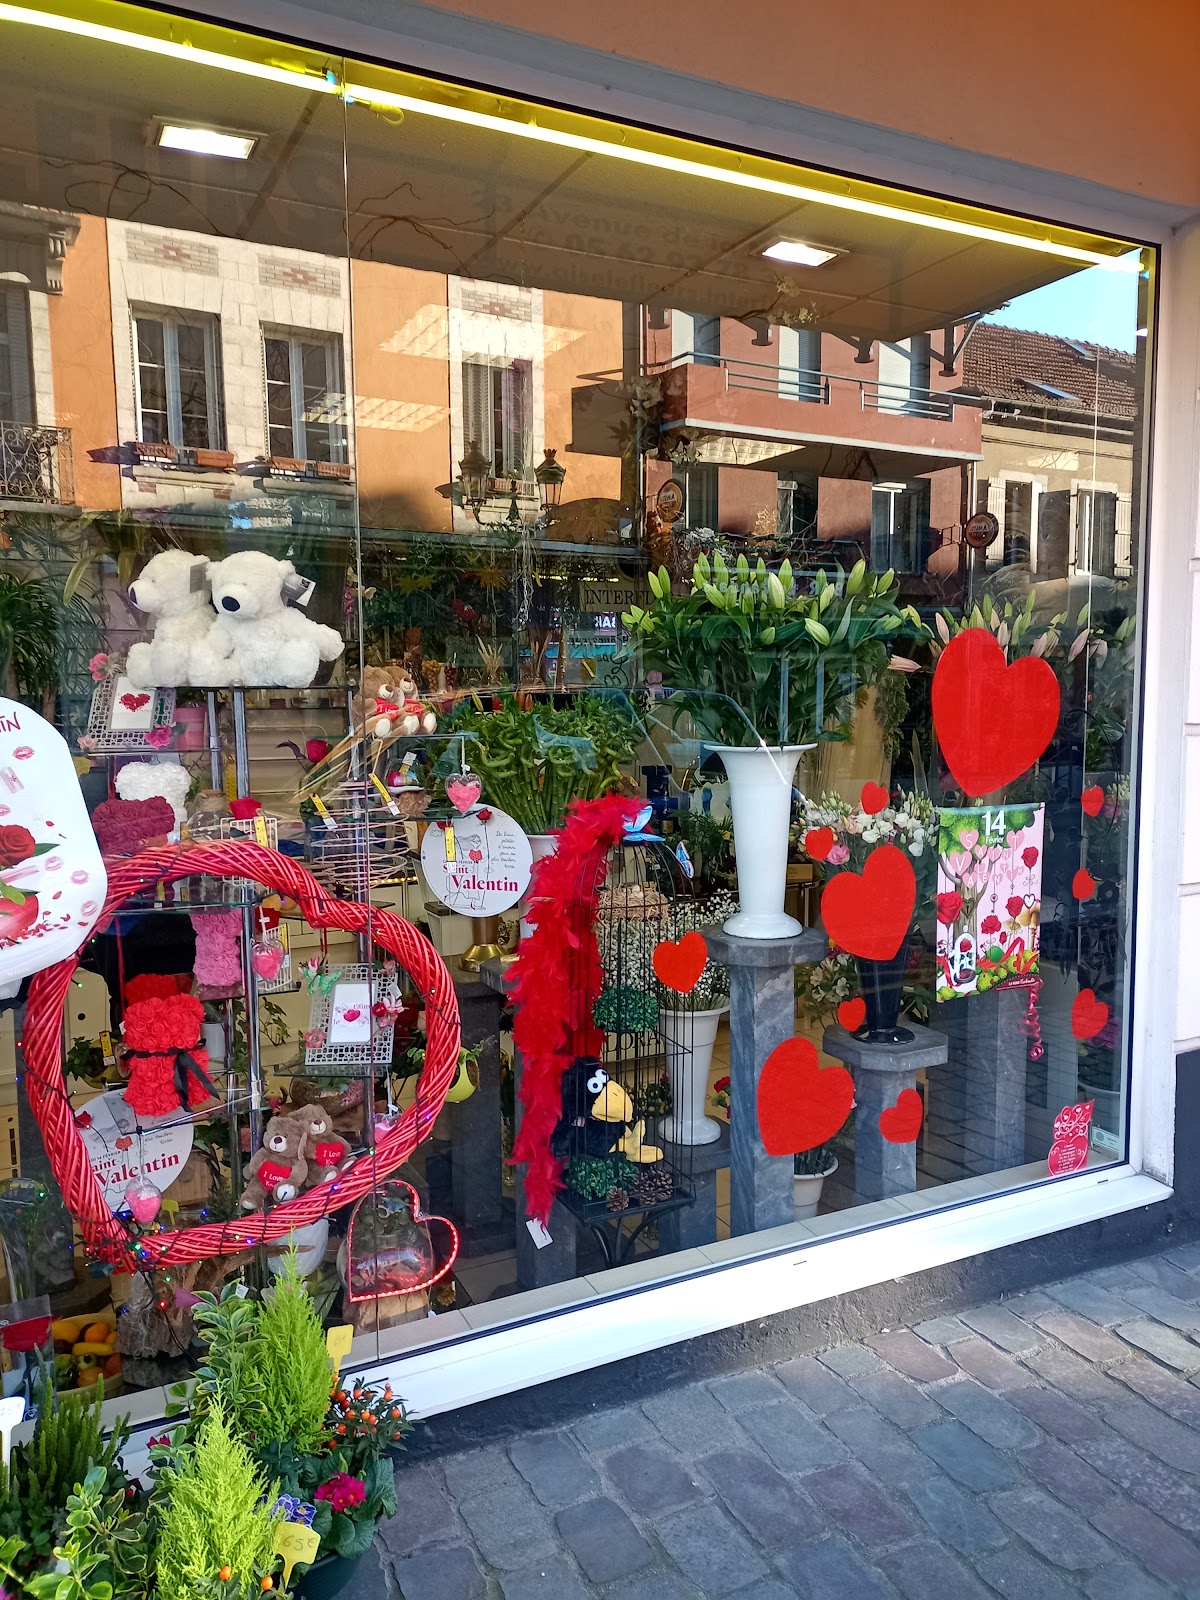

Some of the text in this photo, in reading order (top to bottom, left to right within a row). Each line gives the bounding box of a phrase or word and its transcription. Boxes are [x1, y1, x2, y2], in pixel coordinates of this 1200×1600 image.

[981, 809, 1007, 836] 14
[985, 836, 1005, 846] Février
[442, 864, 473, 875] Sint-
[451, 874, 519, 892] Valentin
[92, 1158, 120, 1173] aint-
[94, 1153, 179, 1186] Valentin
